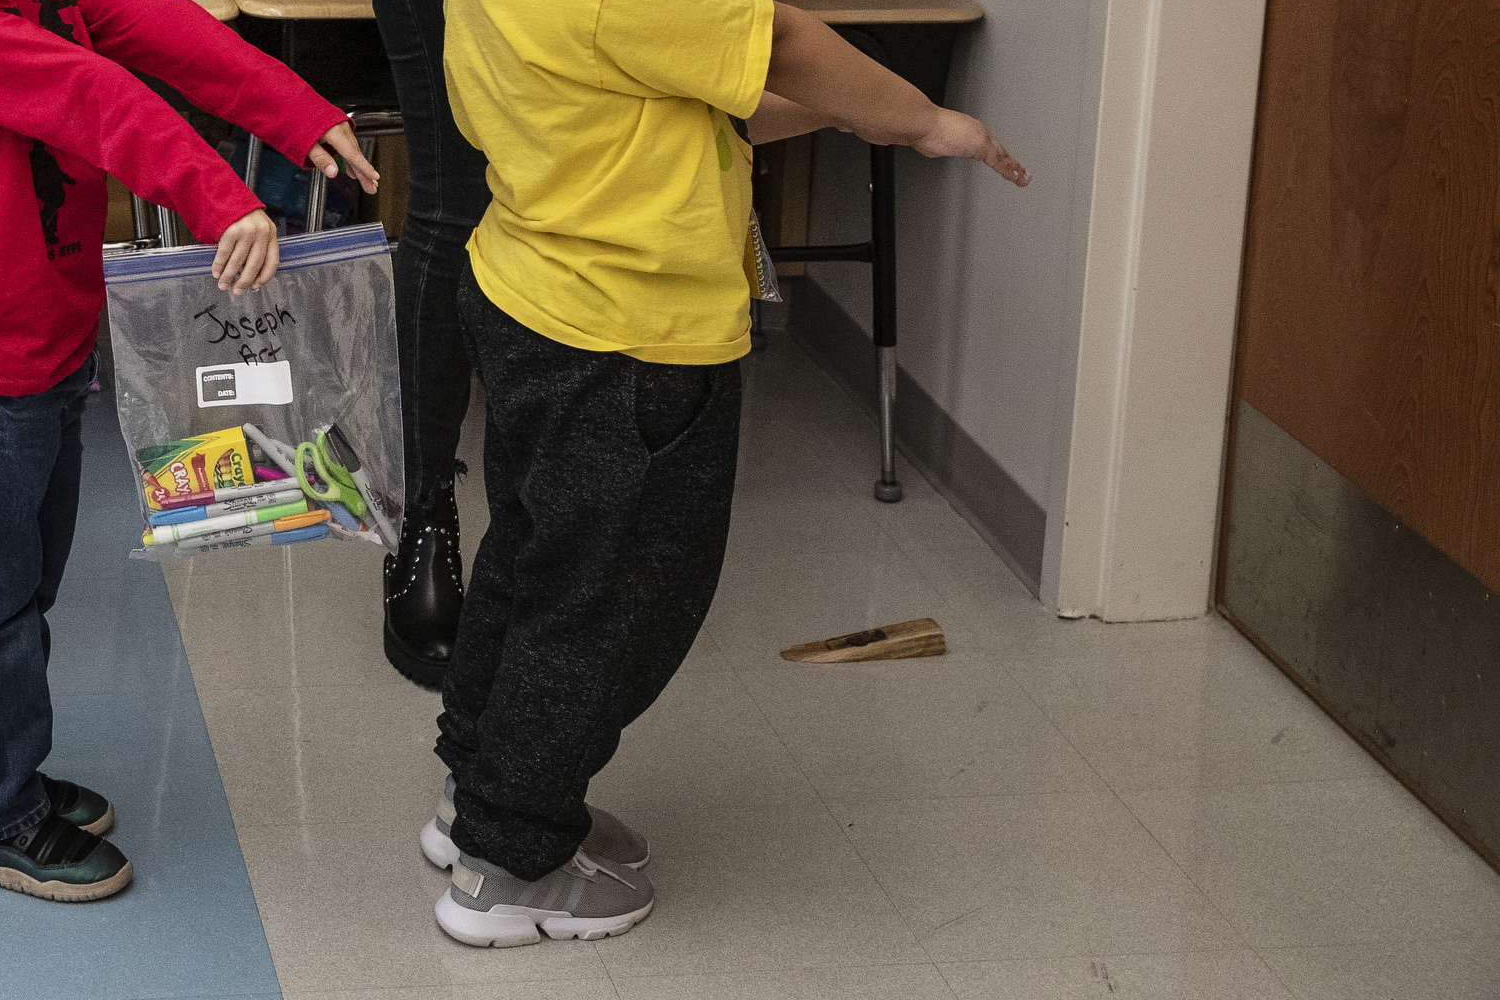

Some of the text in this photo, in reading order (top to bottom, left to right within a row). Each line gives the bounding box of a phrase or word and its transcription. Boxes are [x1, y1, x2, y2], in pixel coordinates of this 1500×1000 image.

[58, 241, 82, 258] HYPE
[193, 302, 296, 344] Joseph
[238, 341, 282, 367] Art
[203, 373, 234, 383] CONTENTS:
[217, 389, 235, 397] DATE:
[170, 461, 192, 495] CRAY
